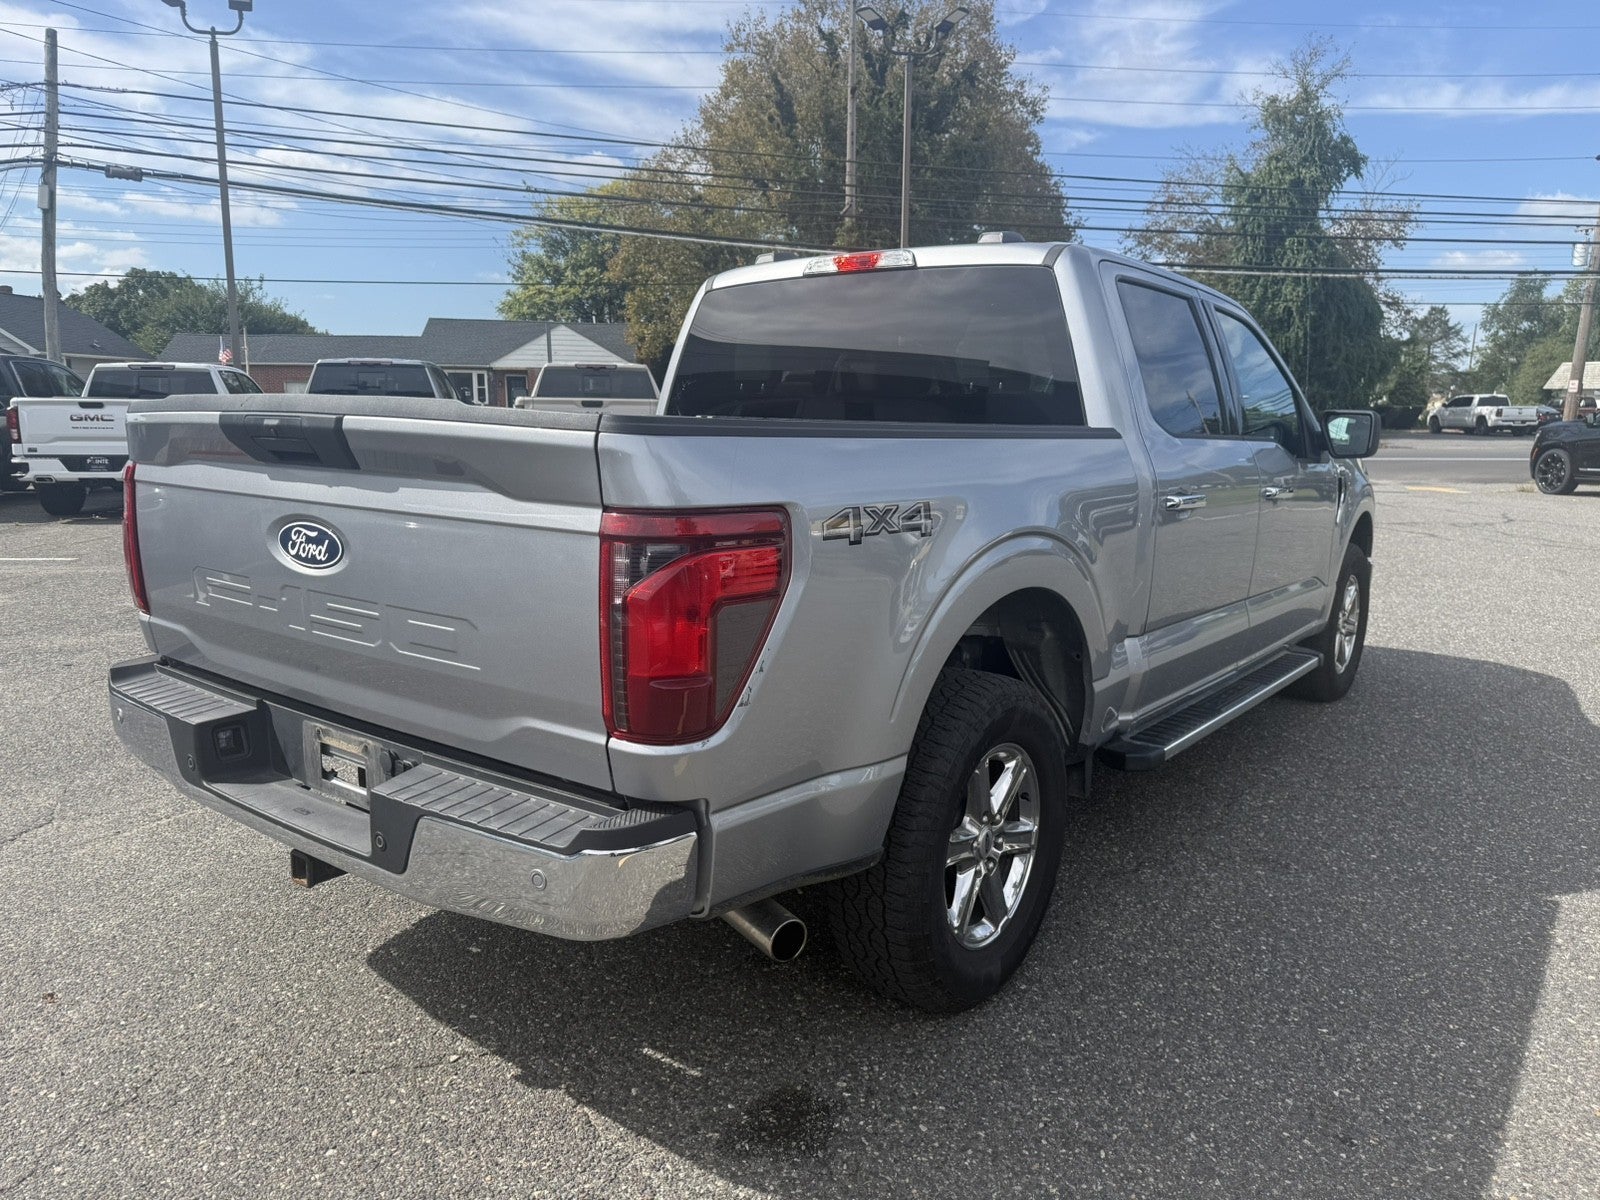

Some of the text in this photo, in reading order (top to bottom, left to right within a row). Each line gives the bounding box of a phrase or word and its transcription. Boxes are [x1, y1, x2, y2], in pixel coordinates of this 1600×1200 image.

[70, 414, 115, 422] GMC
[288, 526, 329, 561] Ford
[822, 501, 933, 546] 4X4
[192, 566, 481, 670] F-150
